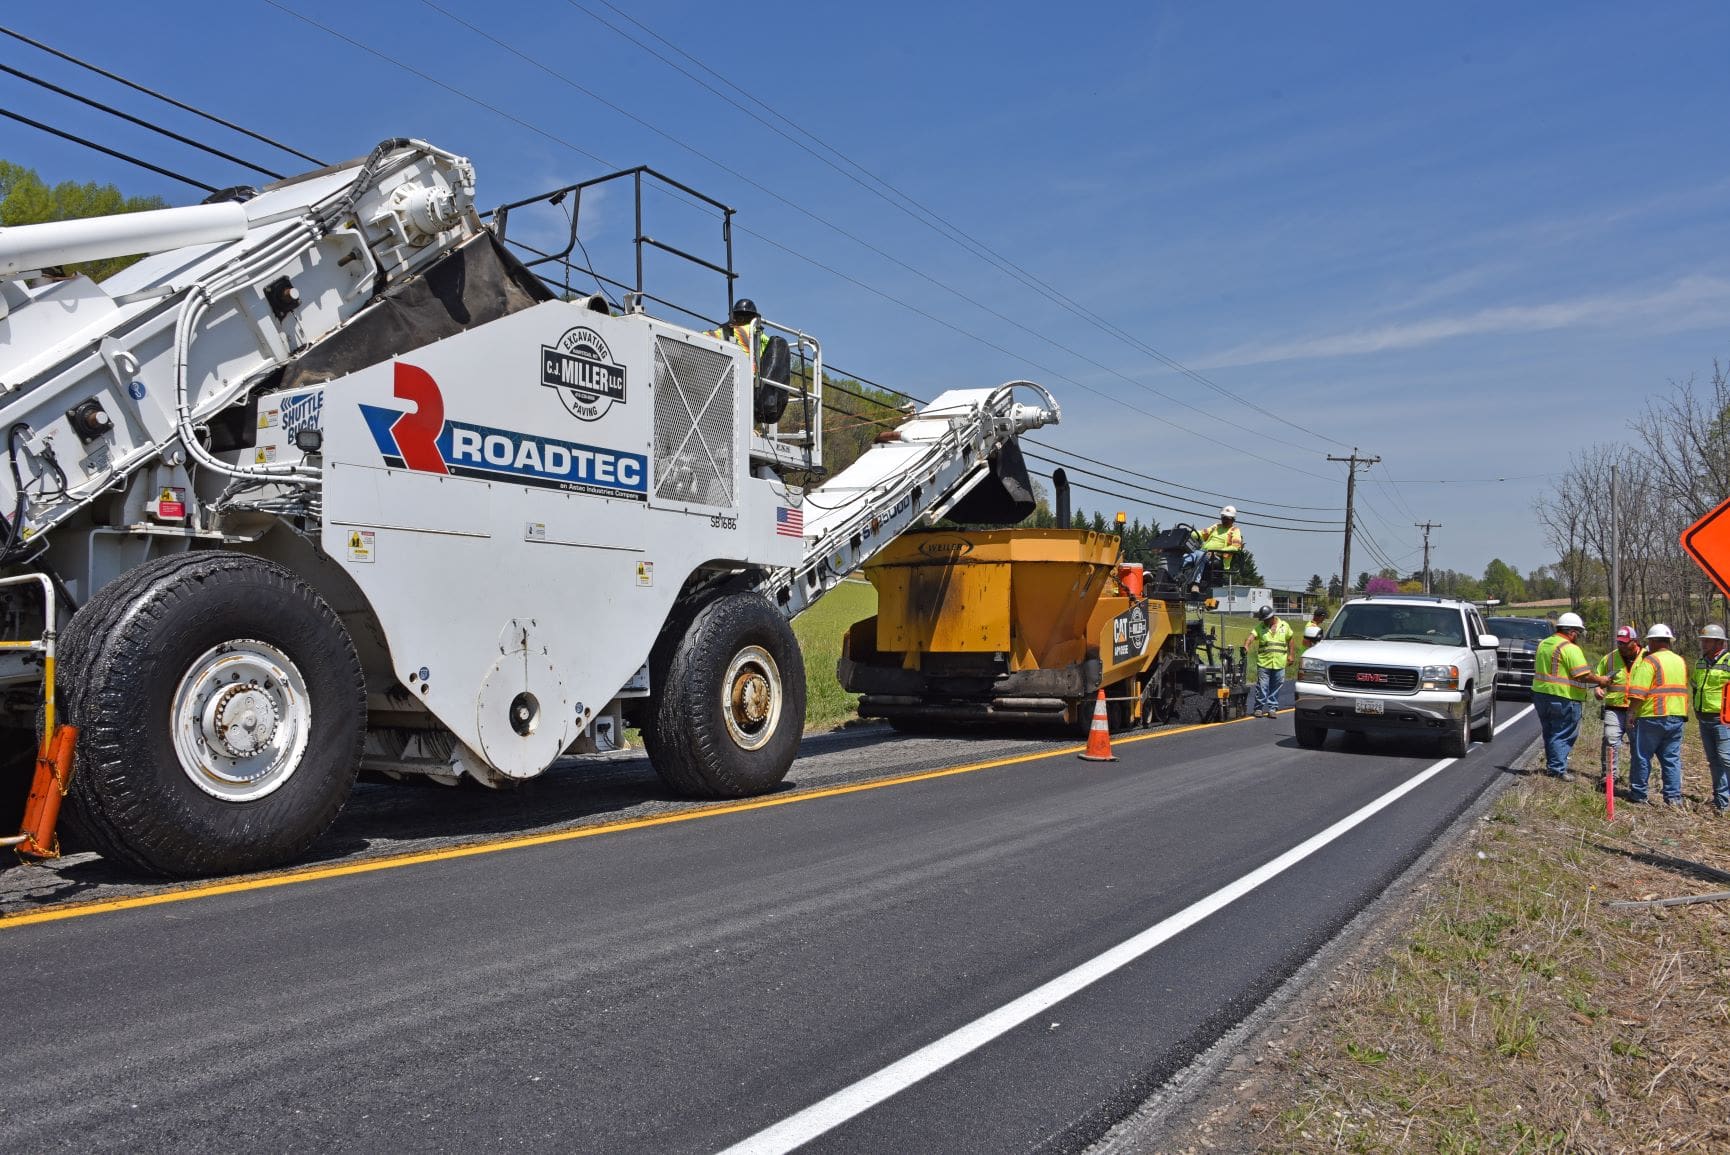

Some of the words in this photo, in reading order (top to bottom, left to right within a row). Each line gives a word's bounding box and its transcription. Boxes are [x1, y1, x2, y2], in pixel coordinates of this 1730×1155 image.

[563, 331, 608, 360] EXCAVATING
[546, 360, 561, 376] C.J.
[561, 358, 609, 393] MILLER
[609, 375, 623, 390] LLC
[282, 390, 324, 431] SHUTTLE
[572, 401, 598, 417] PAVING
[452, 427, 641, 487] ROADTEC
[587, 486, 614, 496] Industries
[928, 543, 962, 552] WEILER
[1113, 618, 1128, 644] CAT
[1355, 672, 1388, 683] GMC
